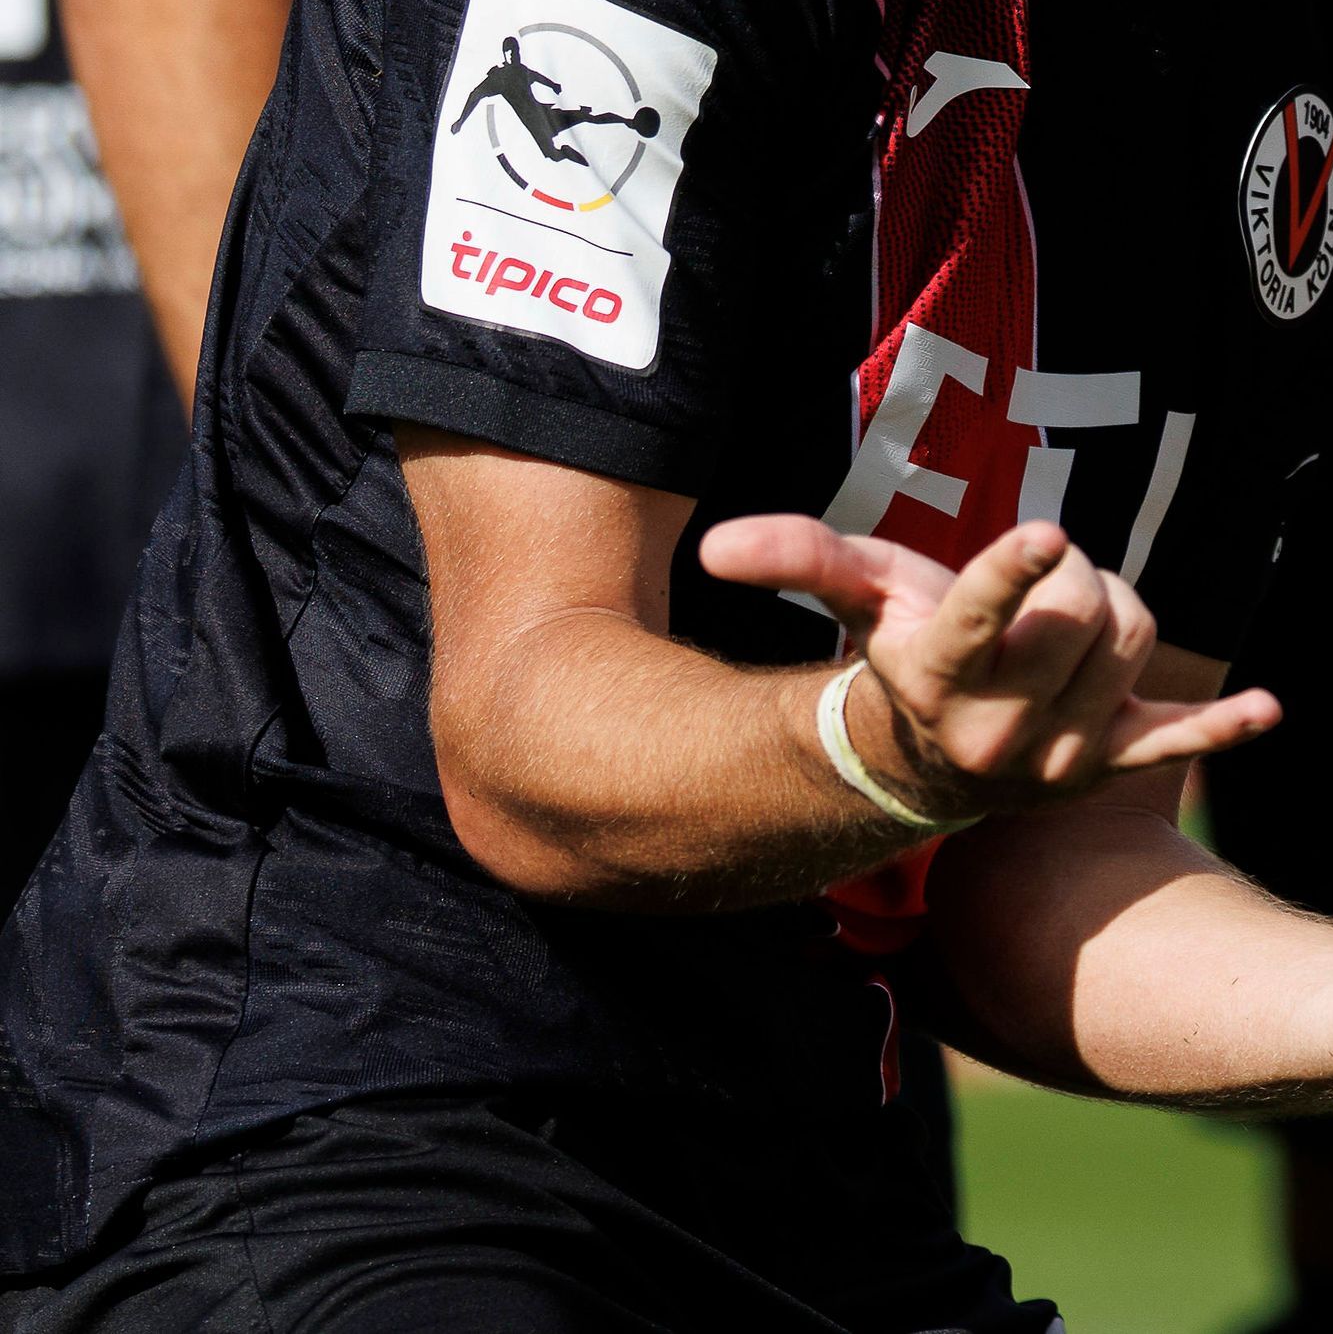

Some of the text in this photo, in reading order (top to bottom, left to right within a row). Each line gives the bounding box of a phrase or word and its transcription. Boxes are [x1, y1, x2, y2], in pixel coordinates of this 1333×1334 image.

[1304, 100, 1330, 140] 1904
[451, 230, 623, 324] tipico
[1251, 165, 1296, 314] VIKTORIA
